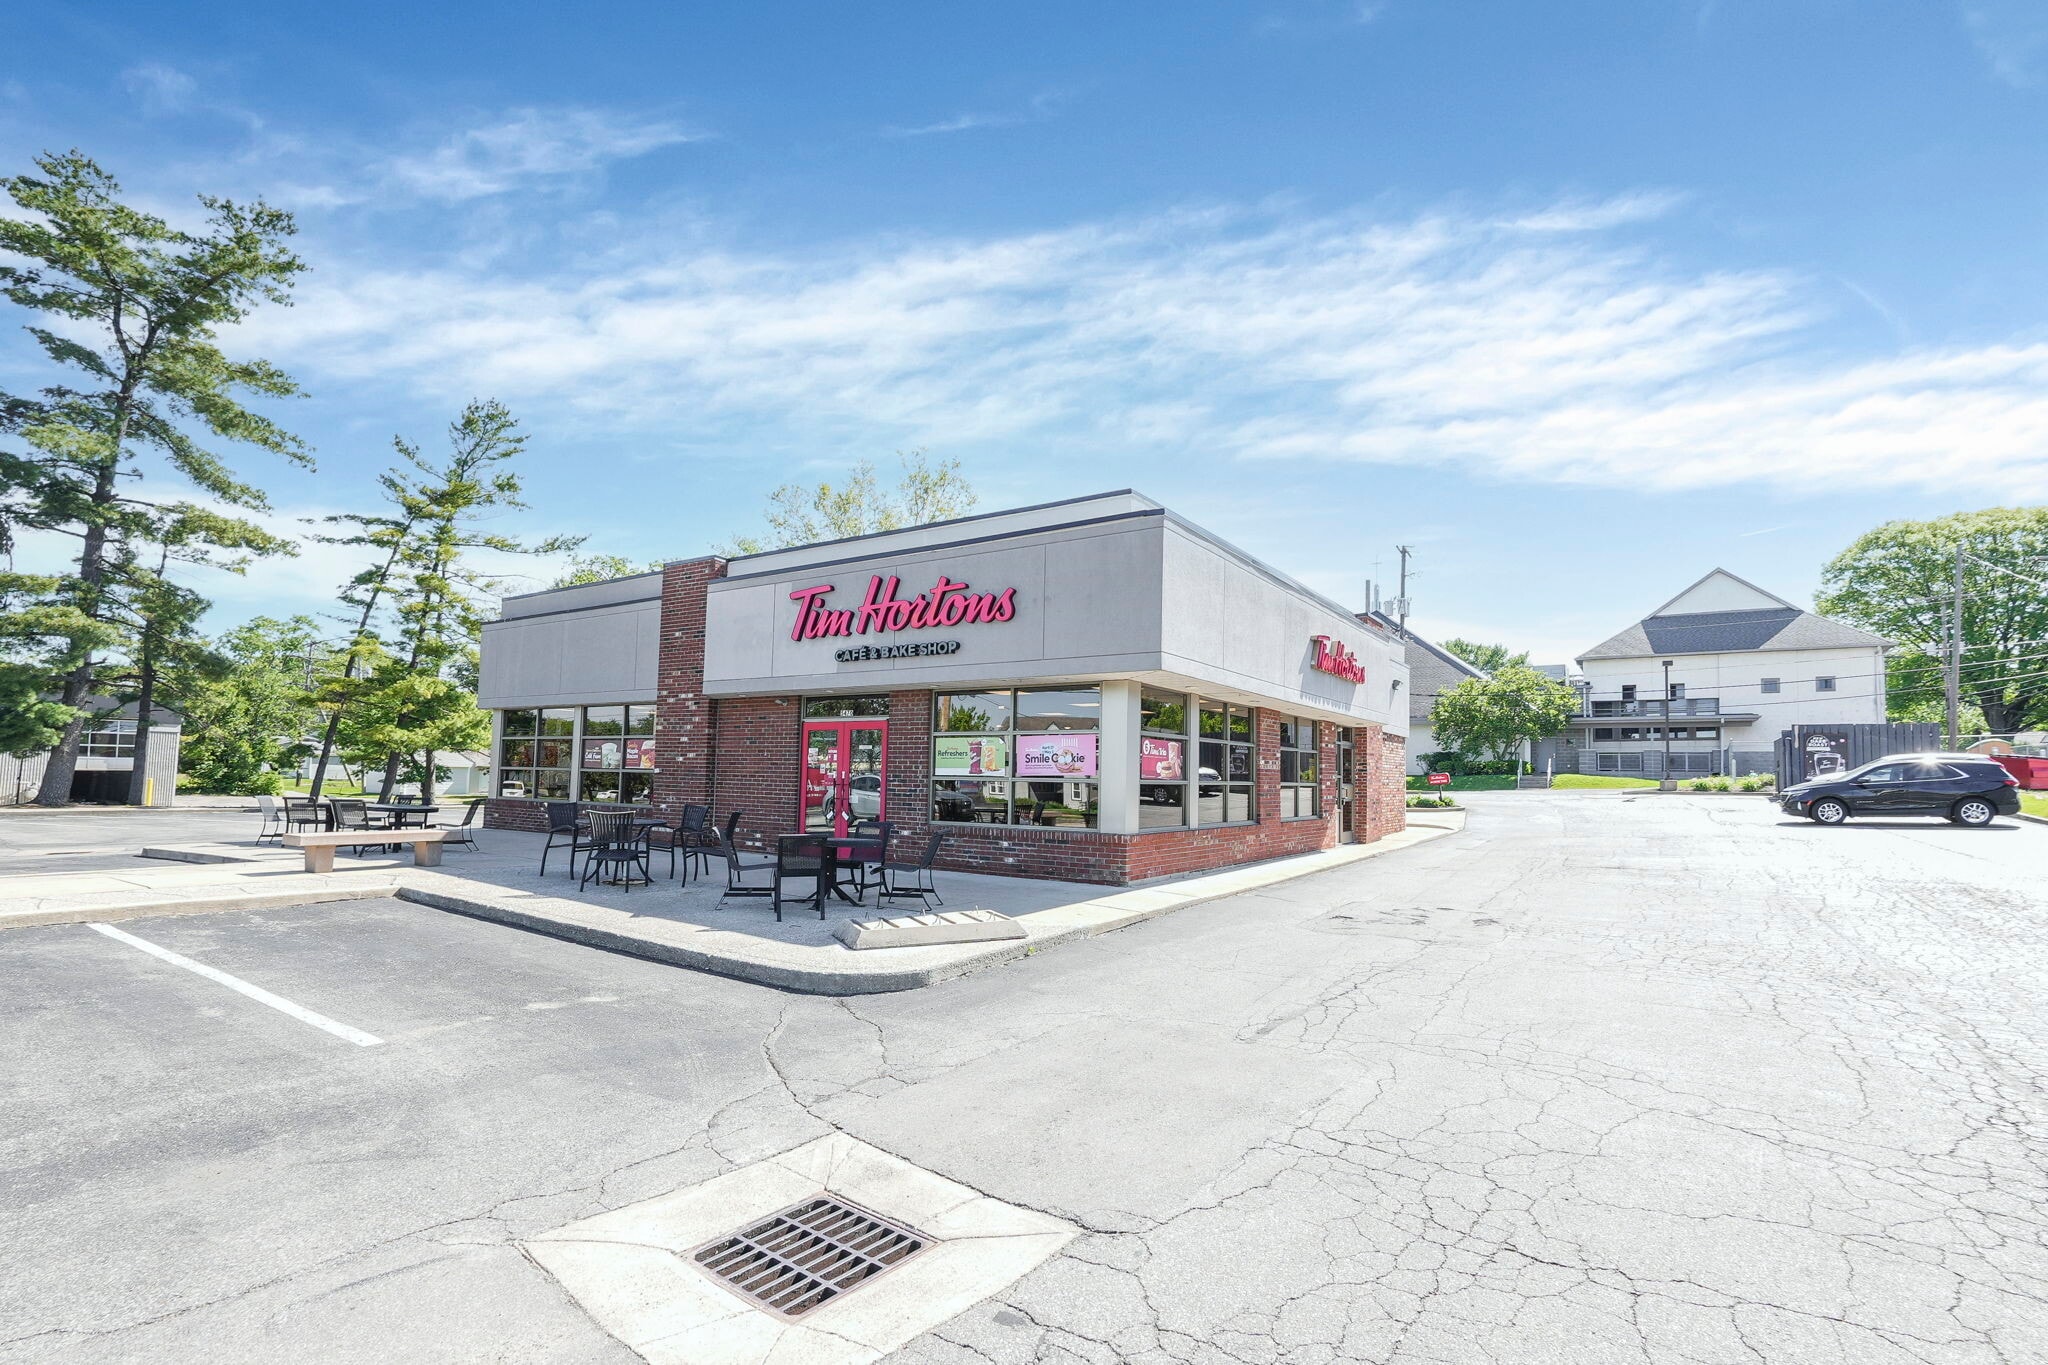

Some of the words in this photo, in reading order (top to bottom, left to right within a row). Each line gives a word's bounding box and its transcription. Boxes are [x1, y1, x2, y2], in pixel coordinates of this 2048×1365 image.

[789, 584, 855, 642] Tim
[856, 574, 1017, 635] Hortons
[834, 645, 866, 662] CAFÉ
[869, 647, 879, 660] &
[881, 643, 916, 658] BAKE
[919, 640, 961, 657] SHOP
[937, 749, 968, 757] Refreshers
[1025, 753, 1050, 764] Smile
[1051, 753, 1085, 764] Ckie
